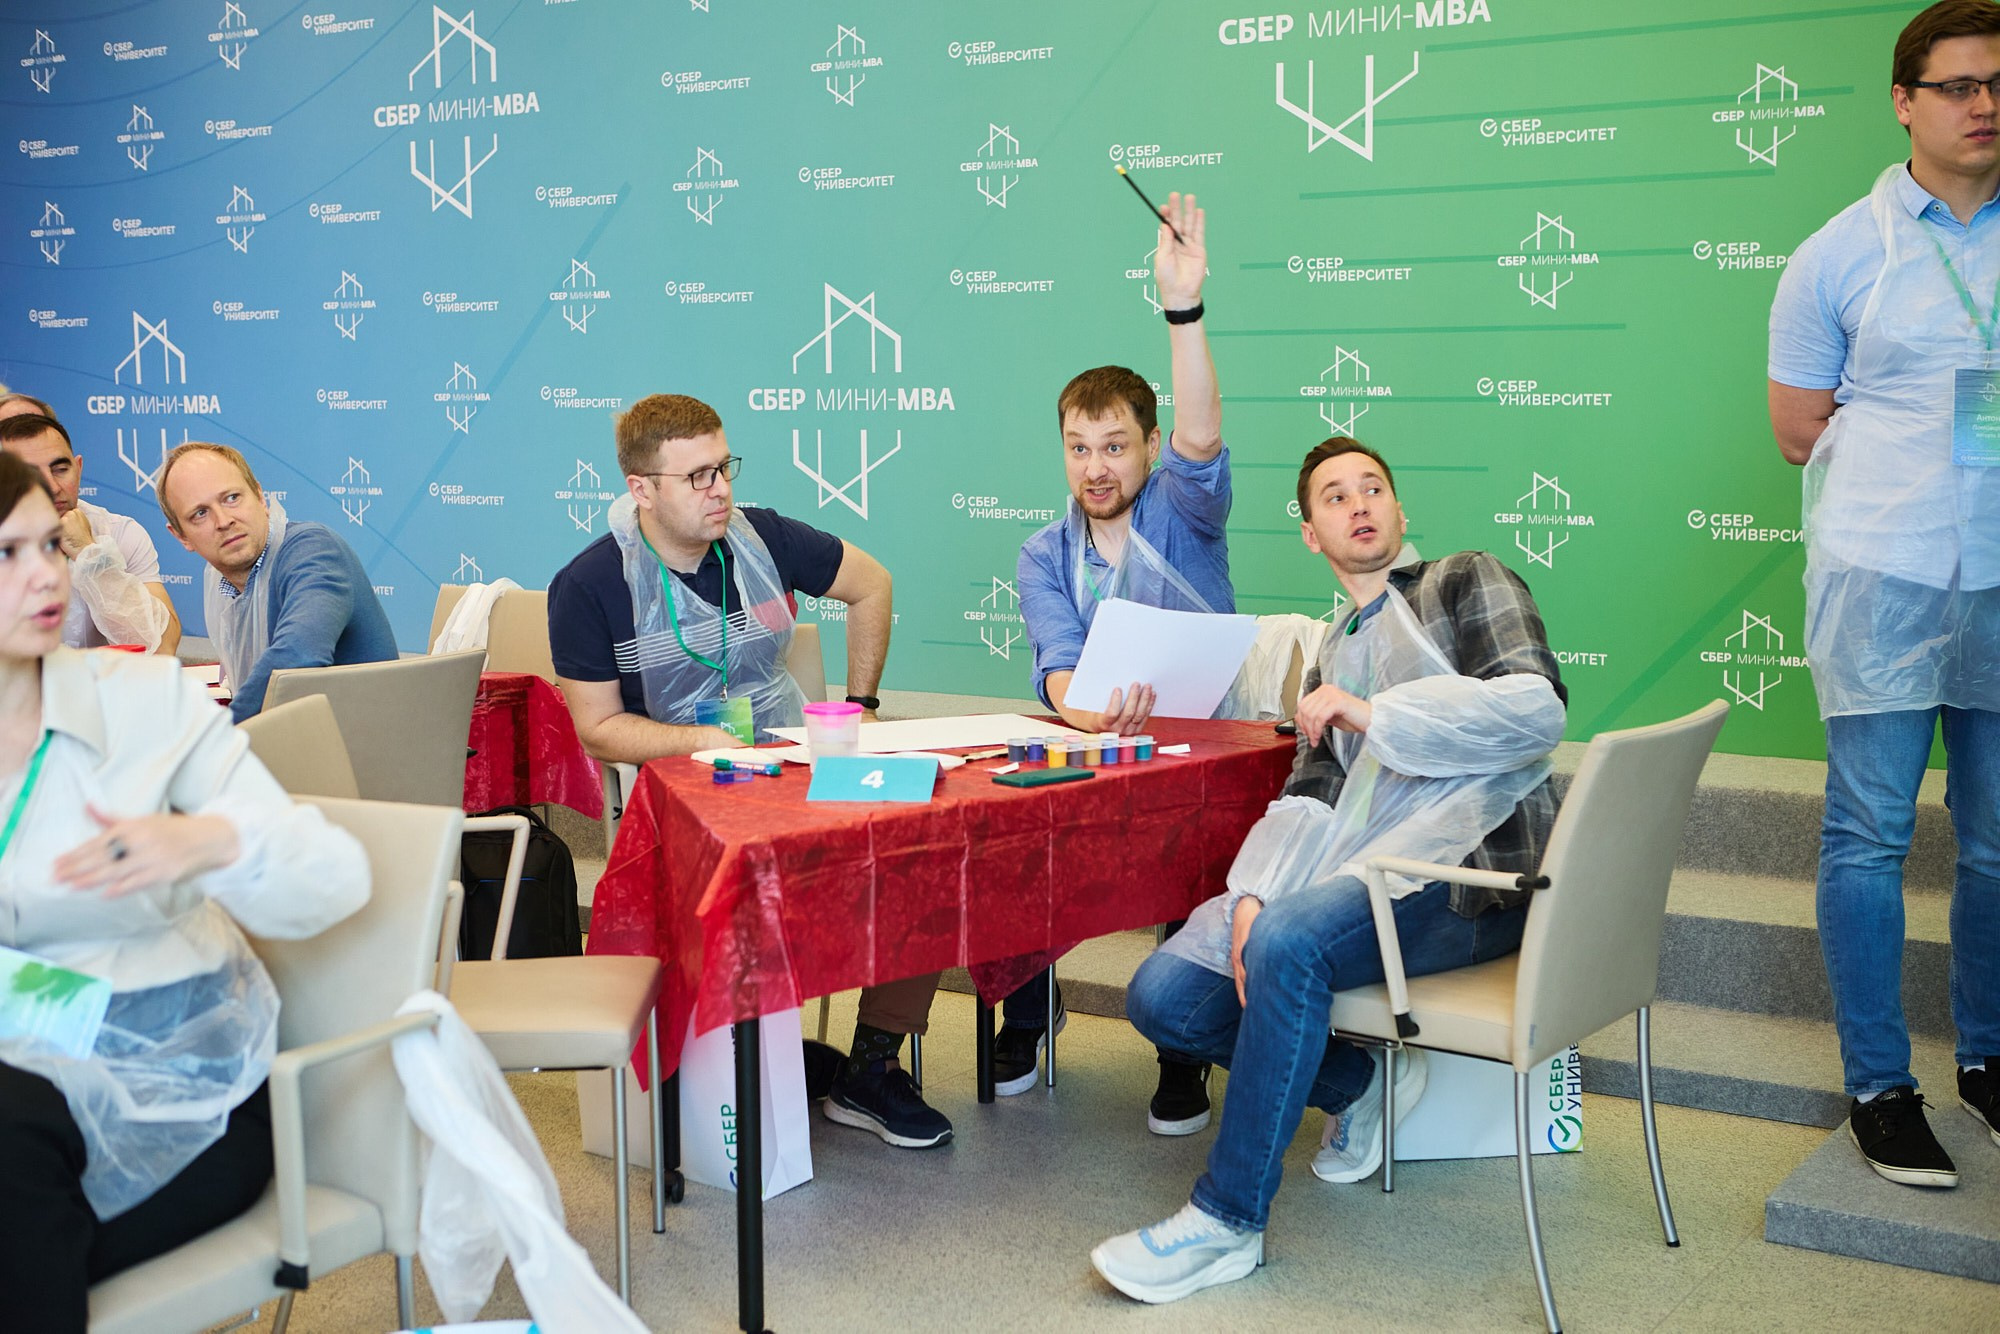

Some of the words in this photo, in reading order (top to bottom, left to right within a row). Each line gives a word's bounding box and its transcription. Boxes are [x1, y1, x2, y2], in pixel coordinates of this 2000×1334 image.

[313, 14, 335, 26] СБЕР
[314, 18, 375, 35] УНИВЕРСИТЕТ
[1218, 14, 1294, 45] СБЕР
[113, 41, 133, 52] СБЕР
[964, 41, 996, 55] СБЕР
[115, 46, 167, 61] УНИВЕРСИТЕТ
[965, 47, 1054, 67] УНИВЕРСИТЕТ
[21, 57, 34, 66] СБЕР
[811, 62, 832, 73] СБЕР
[675, 71, 702, 84] СБЕР
[675, 76, 751, 95] УНИВЕРСИТЕТ
[374, 103, 421, 128] СБЕР
[1712, 110, 1745, 123] СБЕР
[215, 120, 236, 130] СБЕР
[1501, 119, 1542, 133] СБЕР
[216, 126, 272, 140] УНИВЕРСИТЕТ
[1502, 127, 1617, 146] УНИВЕРСИТЕТ
[28, 140, 47, 150] СБЕР
[29, 145, 80, 158] УНИВЕРСИТЕТ
[1127, 144, 1161, 158] СБЕР
[960, 161, 983, 173] СБЕР
[1127, 152, 1223, 170] УНИВЕРСИТЕТ
[813, 167, 842, 179] СБЕР
[672, 182, 692, 192] СБЕР
[814, 175, 895, 192] УНИВЕРСИТЕТ
[548, 186, 573, 198] СБЕР
[549, 193, 618, 209] УНИВЕРСИТЕТ
[320, 204, 342, 214] СБЕР
[321, 210, 381, 224] УНИВЕРСИТЕТ
[122, 219, 142, 229] СБЕР
[1716, 242, 1761, 256] СБЕР
[1307, 257, 1343, 270] СБЕР
[1498, 255, 1527, 266] СБЕР
[1717, 255, 1790, 270] УНИВЕР
[966, 270, 997, 283] СБЕР
[1125, 269, 1150, 279] СБЕР
[1307, 267, 1412, 283] УНИВЕРСИТЕТ
[679, 282, 706, 294] СБЕР
[966, 280, 1054, 295] УНИВЕРСИТЕТ
[434, 293, 457, 304] СБЕР
[679, 292, 754, 304] УНИВЕРСИТЕТ
[223, 302, 243, 312] СБЕР
[435, 301, 499, 314] УНИВЕРСИТЕТ
[38, 310, 56, 320] СБЕР
[1300, 386, 1327, 396] СБЕР
[1498, 380, 1537, 392] СБЕР
[327, 391, 349, 401] СБЕР
[553, 388, 577, 398] СБЕР
[748, 388, 806, 411] СБЕР
[1498, 393, 1612, 406] УНИВЕРСИТЕТ
[87, 396, 126, 415] СБЕР
[554, 398, 622, 408] УНИВЕРСИТЕТ
[440, 485, 463, 494] СБЕР
[968, 496, 999, 507] СБЕР
[969, 508, 1055, 522] УНИВЕРСИТЕТ
[1494, 513, 1523, 524] СБЕР
[1710, 513, 1754, 527] СБЕР
[1711, 527, 1804, 543] УНИВЕРСИ
[820, 600, 848, 610] СБЕР
[964, 611, 987, 622] СБЕР
[1700, 651, 1732, 663] СБЕР
[861, 770, 884, 789] 4
[1549, 1058, 1564, 1112] СБЕР
